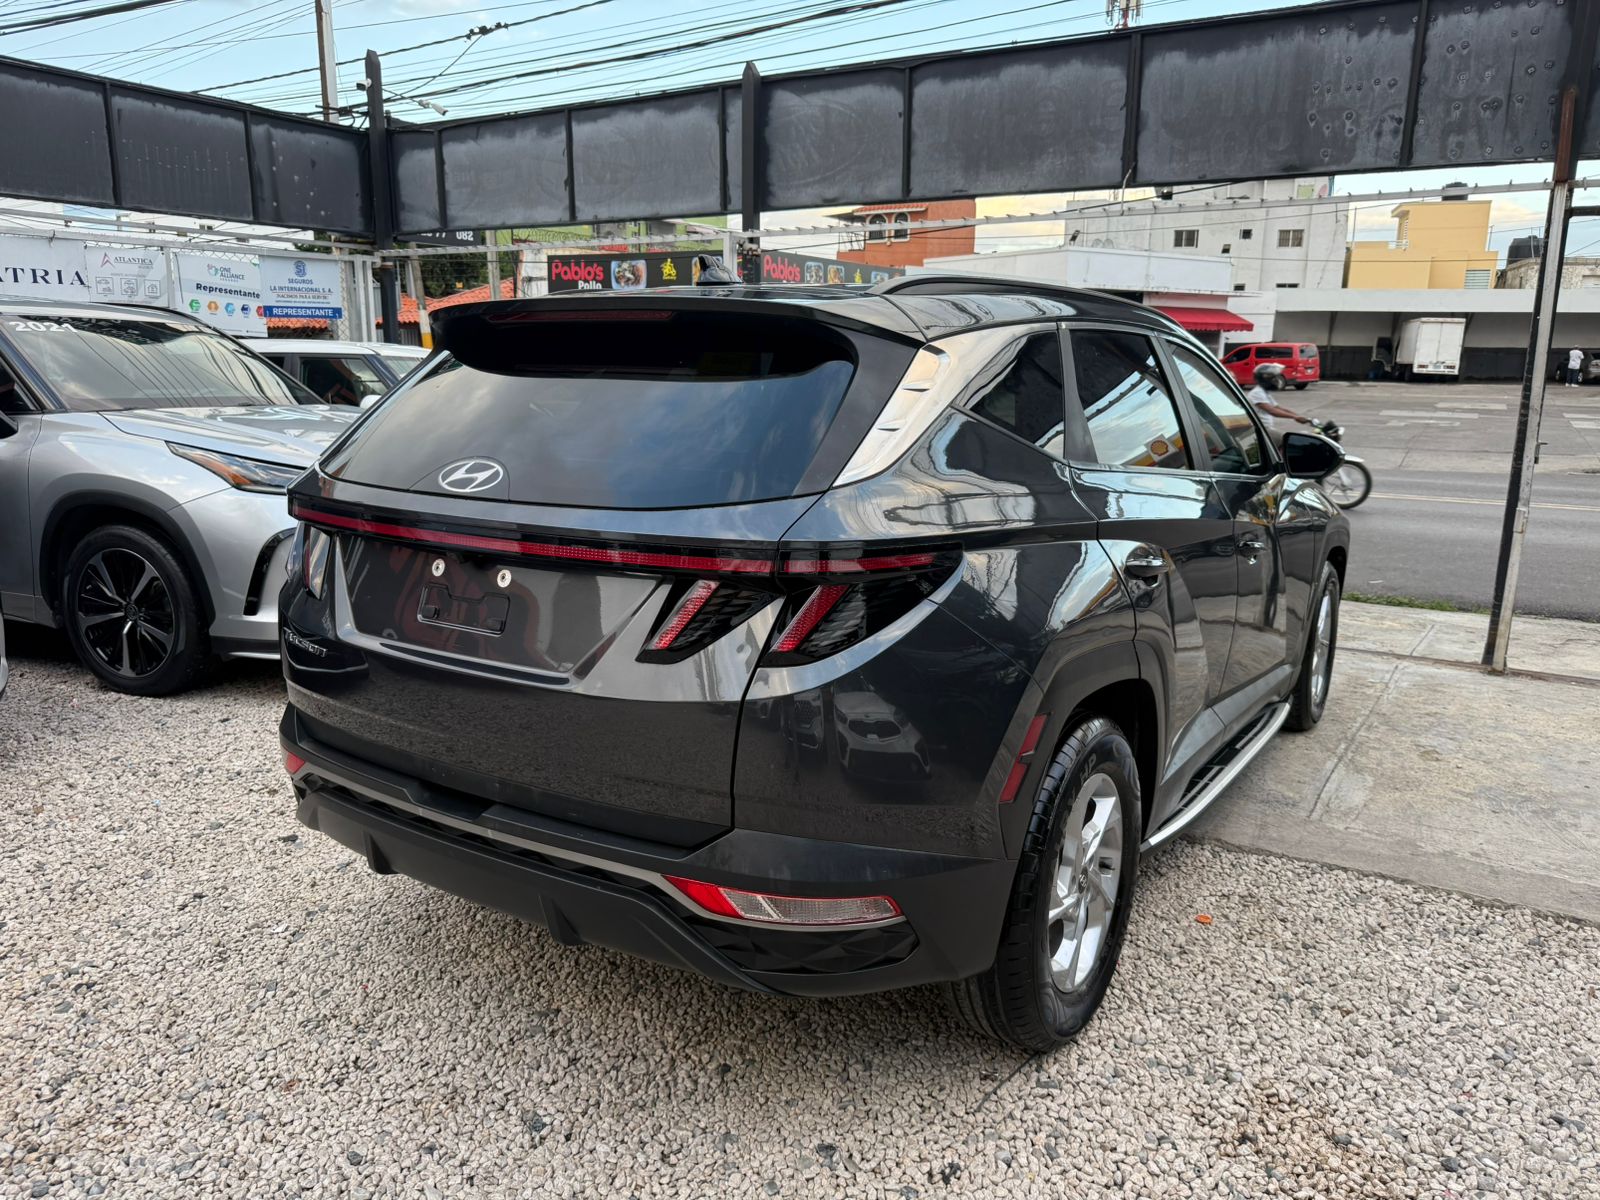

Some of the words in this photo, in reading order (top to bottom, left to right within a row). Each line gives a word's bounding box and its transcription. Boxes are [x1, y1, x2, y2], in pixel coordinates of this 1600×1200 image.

[114, 257, 153, 265] ATLANTICA
[551, 259, 604, 281] Pablo's
[764, 254, 800, 282] Pablo's
[220, 272, 246, 280] ALLIANCE
[578, 280, 602, 289] Pollo
[196, 283, 261, 299] Representante
[272, 308, 334, 316] REPRESENTANTE
[9, 321, 78, 333] 2021
